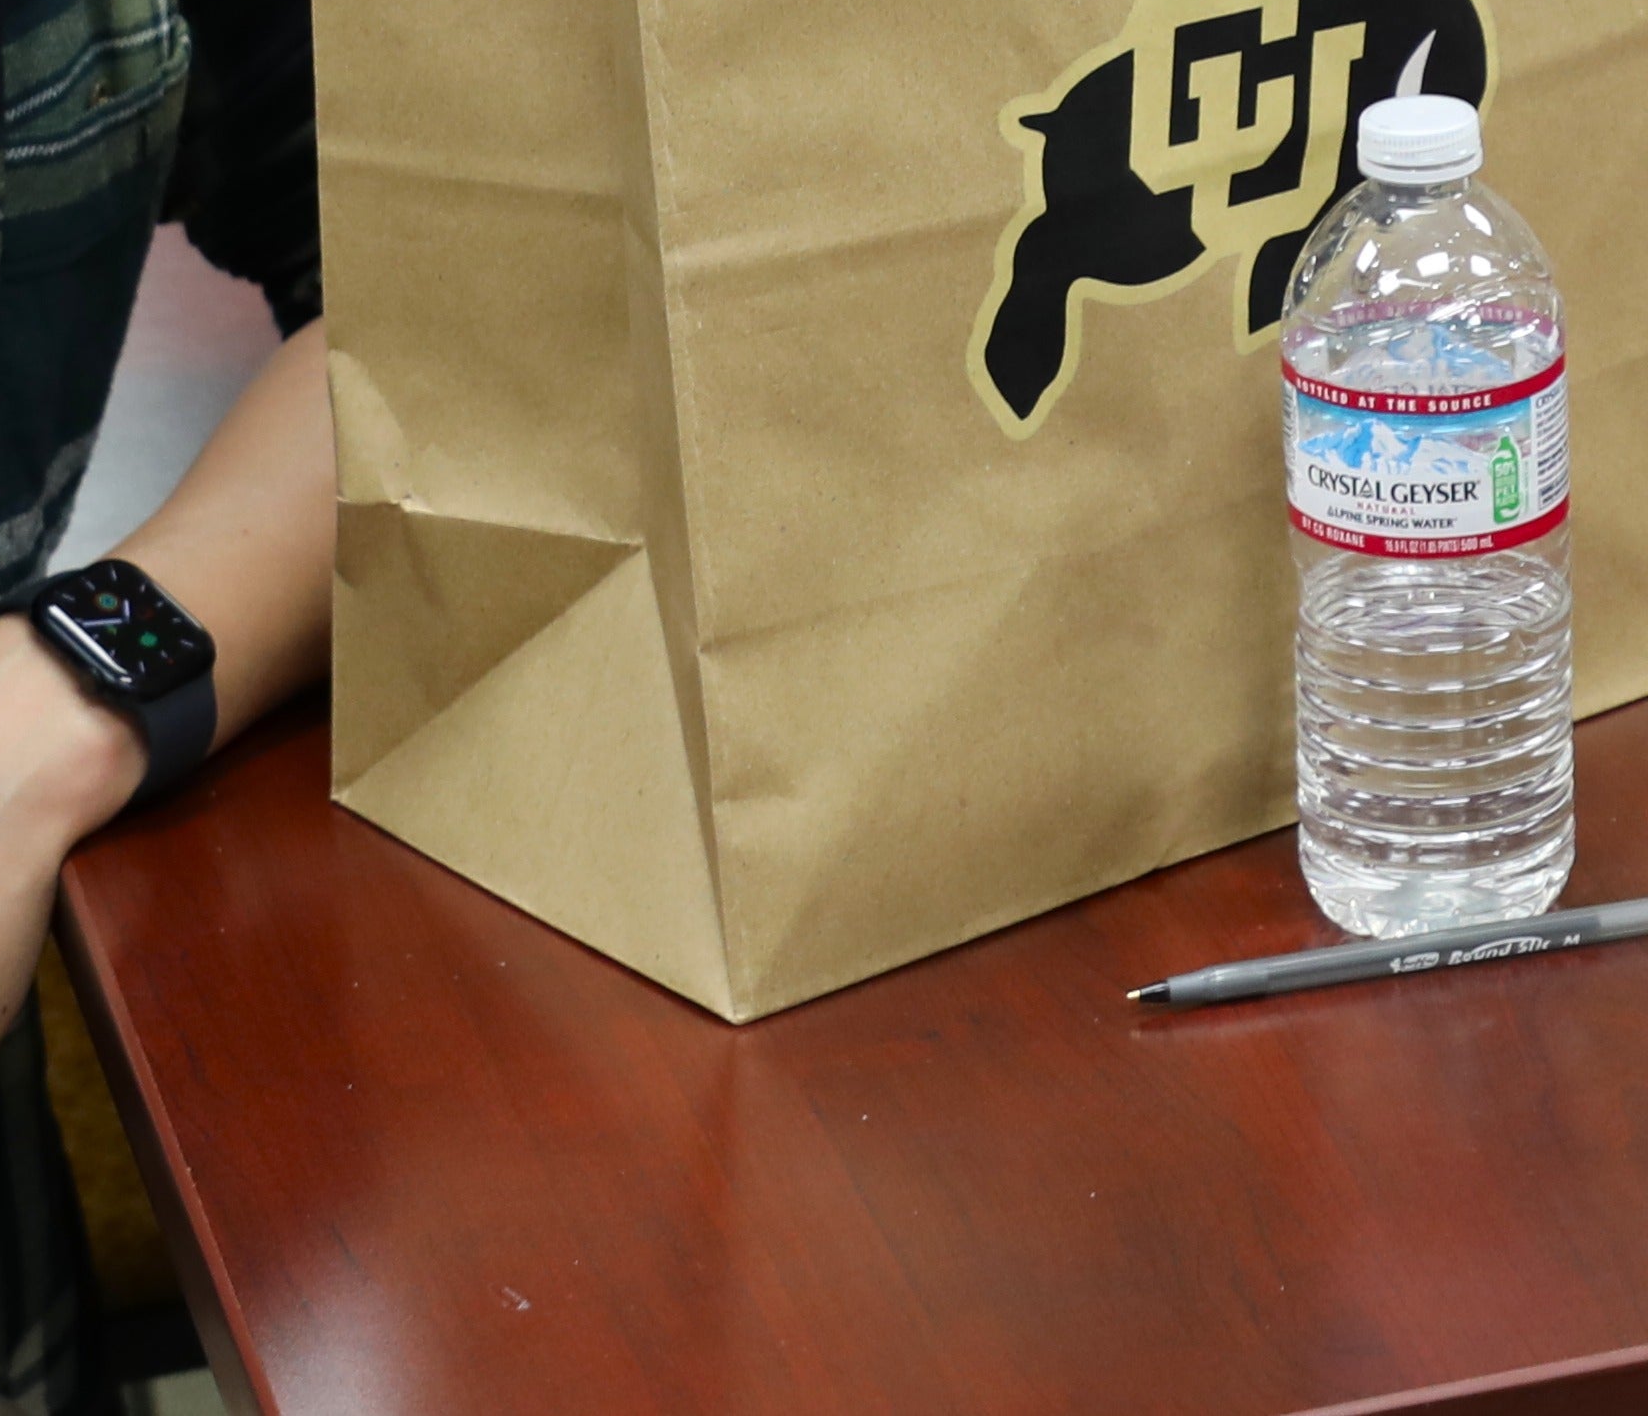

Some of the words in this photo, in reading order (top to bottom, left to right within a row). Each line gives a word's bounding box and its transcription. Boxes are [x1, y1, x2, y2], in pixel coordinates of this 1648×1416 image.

[1358, 395, 1376, 409] AT
[1386, 398, 1417, 412] THE
[1427, 394, 1492, 413] SOURCE
[1308, 464, 1388, 503] CRYSTAL
[1390, 480, 1478, 505] GEYSER
[1326, 505, 1363, 523] ALPINE
[1365, 514, 1410, 530] SPRING
[1412, 517, 1455, 530] WATER
[1356, 501, 1417, 516] NATURAL
